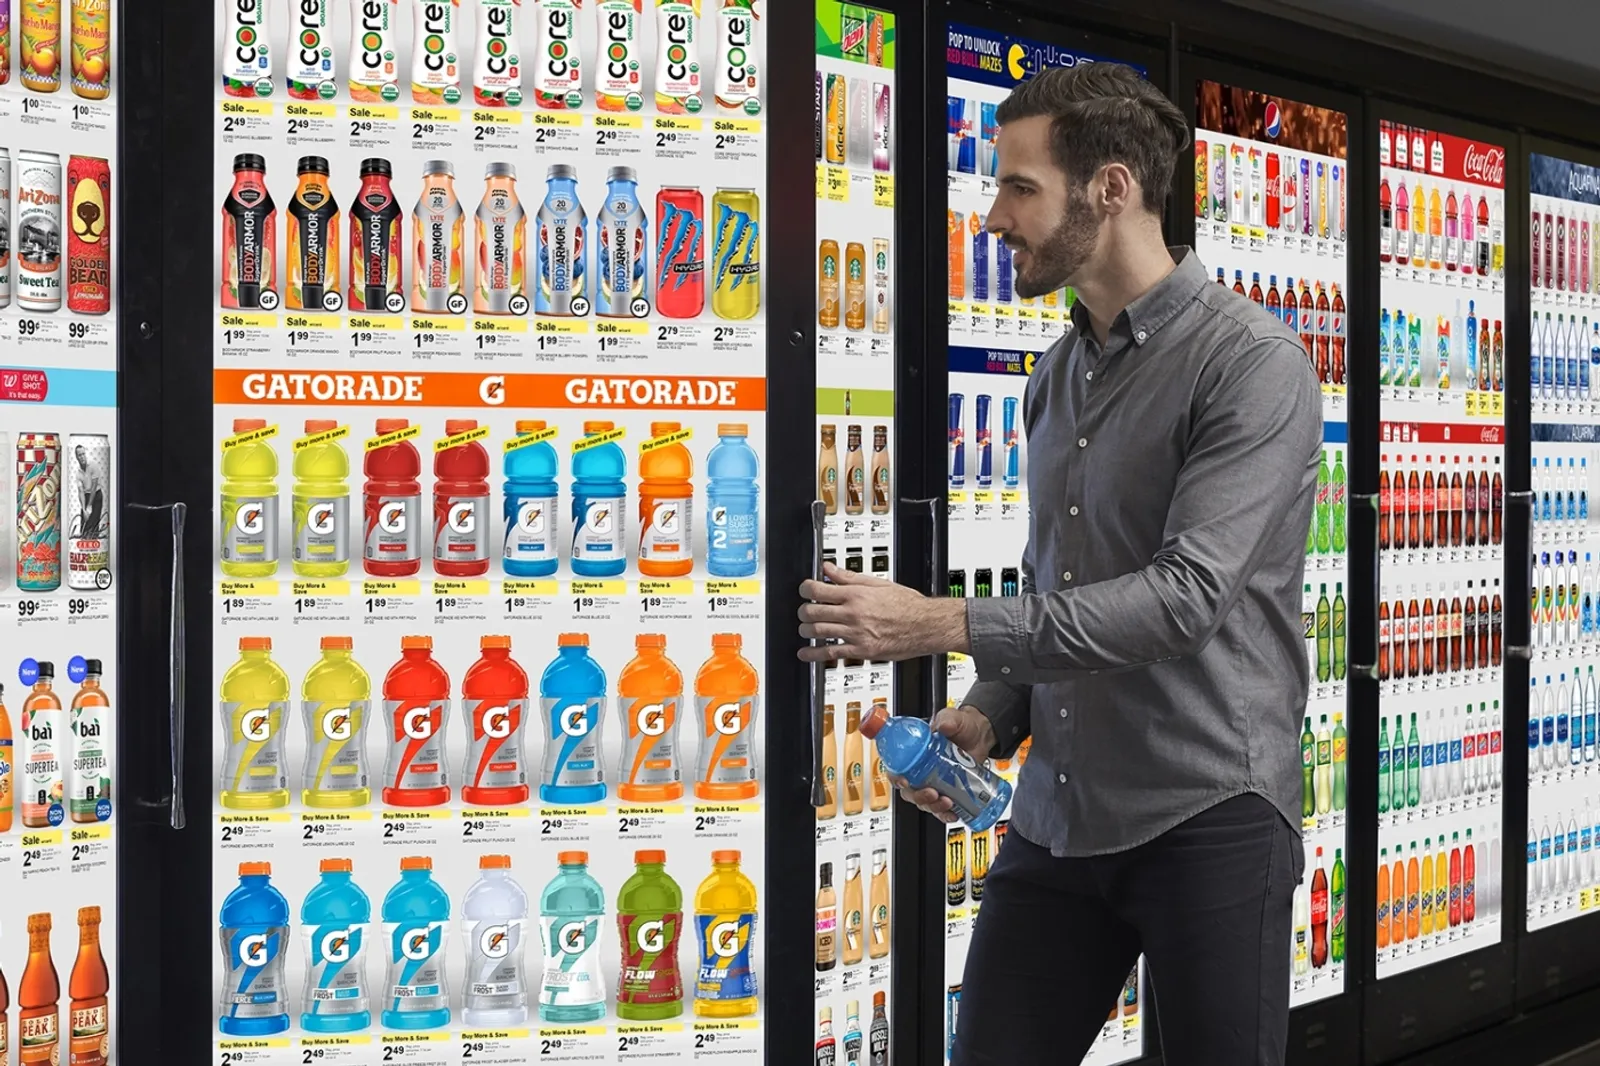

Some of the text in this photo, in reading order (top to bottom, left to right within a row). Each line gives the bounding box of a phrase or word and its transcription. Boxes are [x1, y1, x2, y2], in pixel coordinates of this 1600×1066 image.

[362, 3, 382, 68] core
[424, 4, 444, 70] core
[488, 7, 506, 74] core
[549, 10, 567, 76] core
[608, 12, 627, 78] core
[668, 14, 686, 80] core
[949, 32, 1001, 56] POP TO UNLOCK
[728, 17, 745, 83] core
[947, 48, 1003, 73] RED BULL MAZES
[224, 103, 244, 112] Sale
[413, 110, 432, 119] Sale
[596, 117, 615, 125] Sale
[715, 122, 734, 130] Sale
[243, 210, 255, 283] BODYARMOR
[307, 212, 319, 284] BODYARMOR
[370, 214, 381, 285] BODYARMOR
[432, 223, 443, 289] BODYARMOR
[494, 225, 505, 290] BODYARMOR
[556, 226, 566, 291] BODYARMOR
[616, 226, 626, 292] BODYARMOR
[19, 274, 43, 287] Sweet
[70, 268, 108, 287] BEAR
[262, 296, 274, 305] GF
[325, 297, 338, 306] GF
[388, 298, 402, 307] GF
[451, 300, 463, 308] GF
[513, 301, 525, 309] GF
[575, 303, 586, 311] GF
[634, 304, 646, 312] GF
[287, 317, 307, 326] Sale
[475, 321, 494, 329] Sale
[242, 373, 423, 401] GATORADE
[565, 378, 736, 405] GATORADE
[225, 438, 236, 448] Buy
[238, 435, 253, 443] more
[261, 428, 275, 437] save
[222, 583, 233, 591] Buy
[32, 721, 52, 740] bai
[81, 718, 100, 737] bai
[25, 761, 59, 774] SUPERTEA
[73, 757, 107, 770] SUPERTEA
[23, 836, 39, 845] Sale
[72, 831, 88, 840] Sale
[624, 969, 655, 980] FLOW
[699, 968, 729, 978] FLOW
[73, 1014, 98, 1027] PEAK
[23, 1023, 48, 1036] PEAK
